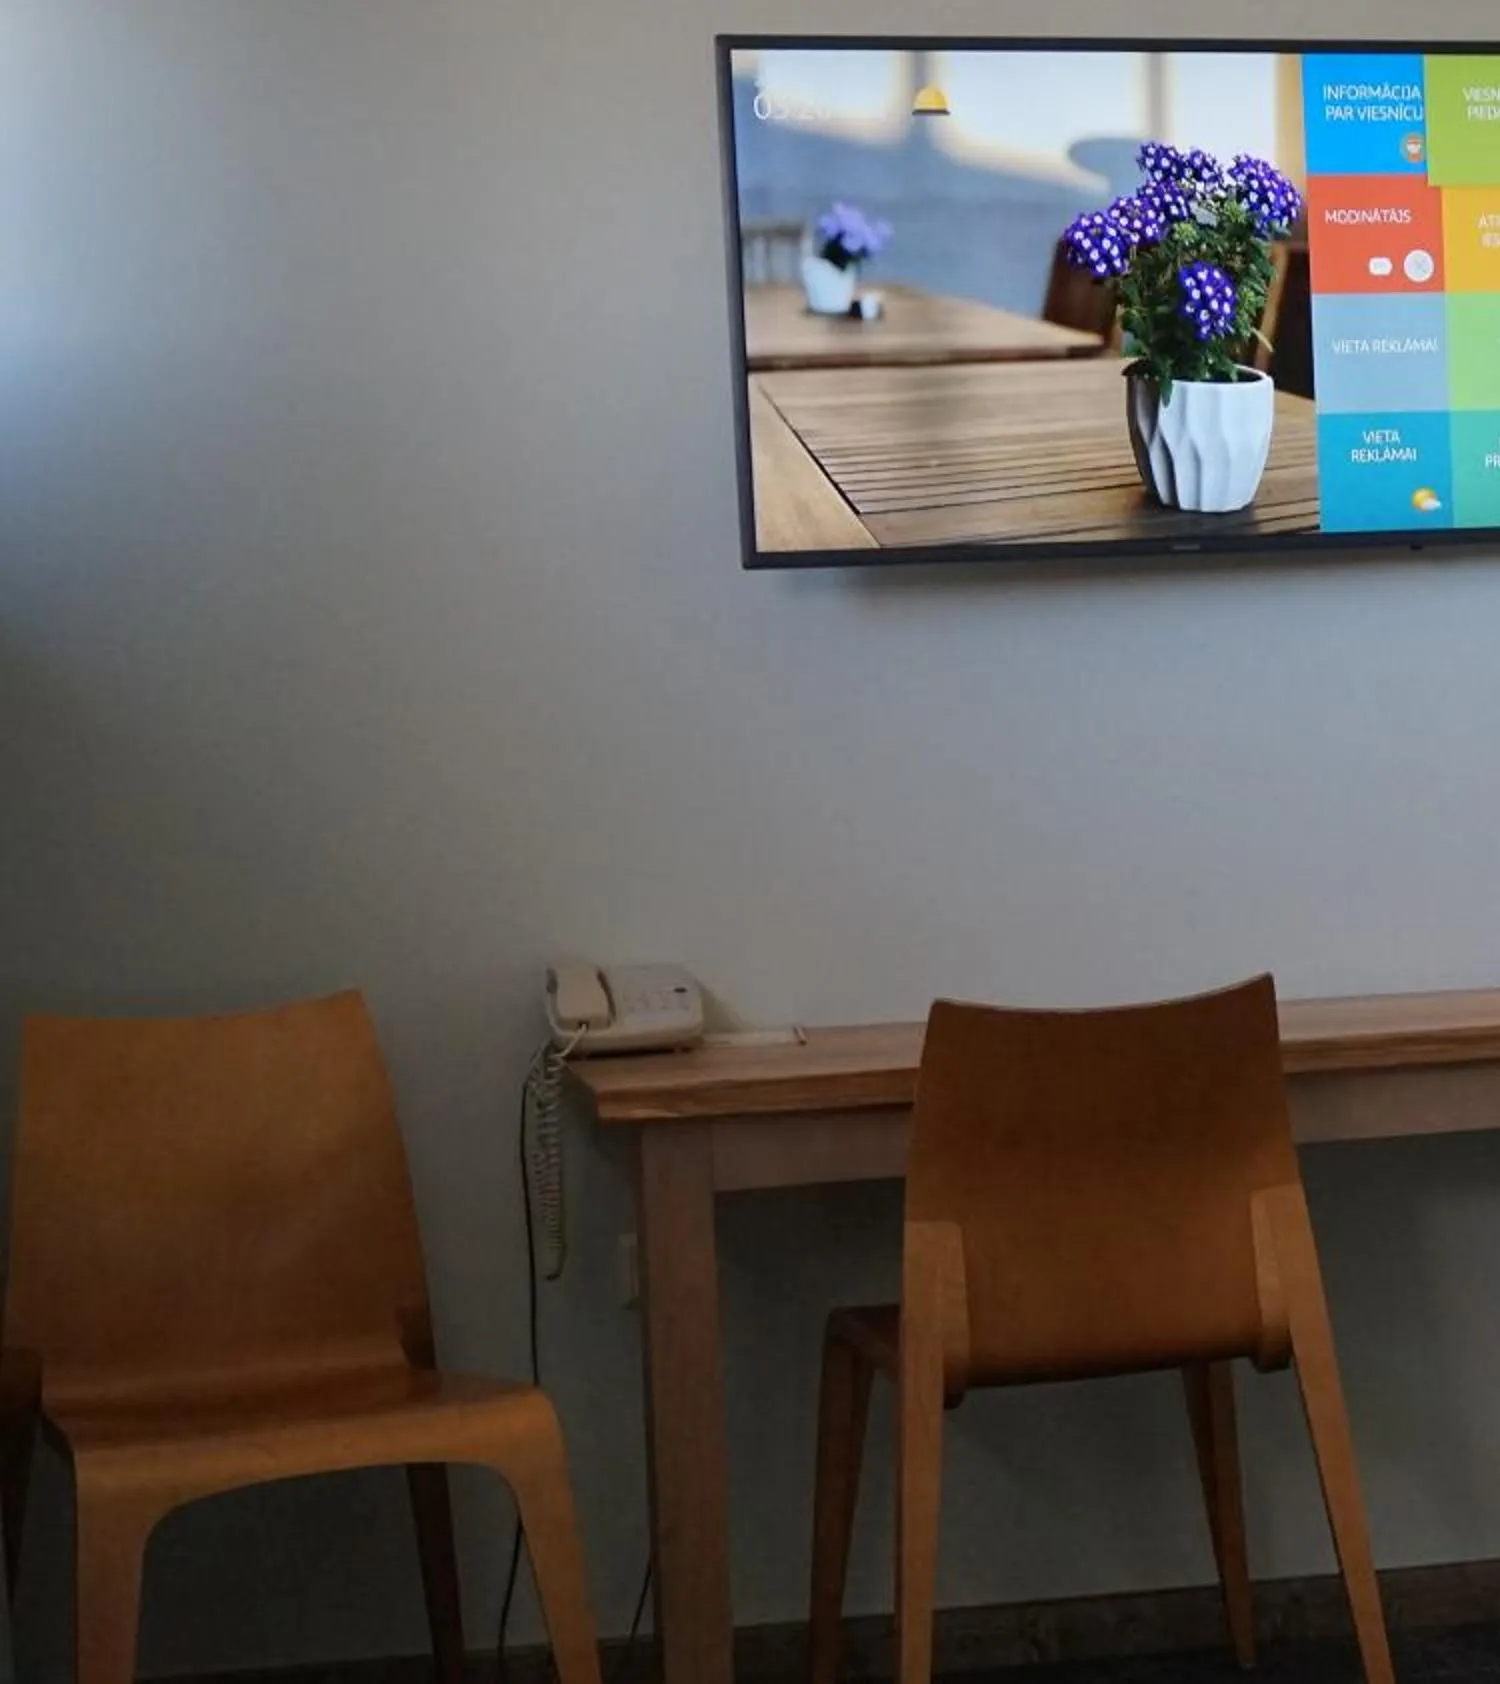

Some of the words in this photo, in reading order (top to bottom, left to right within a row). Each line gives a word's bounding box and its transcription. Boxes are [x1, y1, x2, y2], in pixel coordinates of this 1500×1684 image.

[1325, 104, 1353, 121] PAR
[1332, 337, 1369, 354] VIETA
[1362, 429, 1401, 445] VIETA
